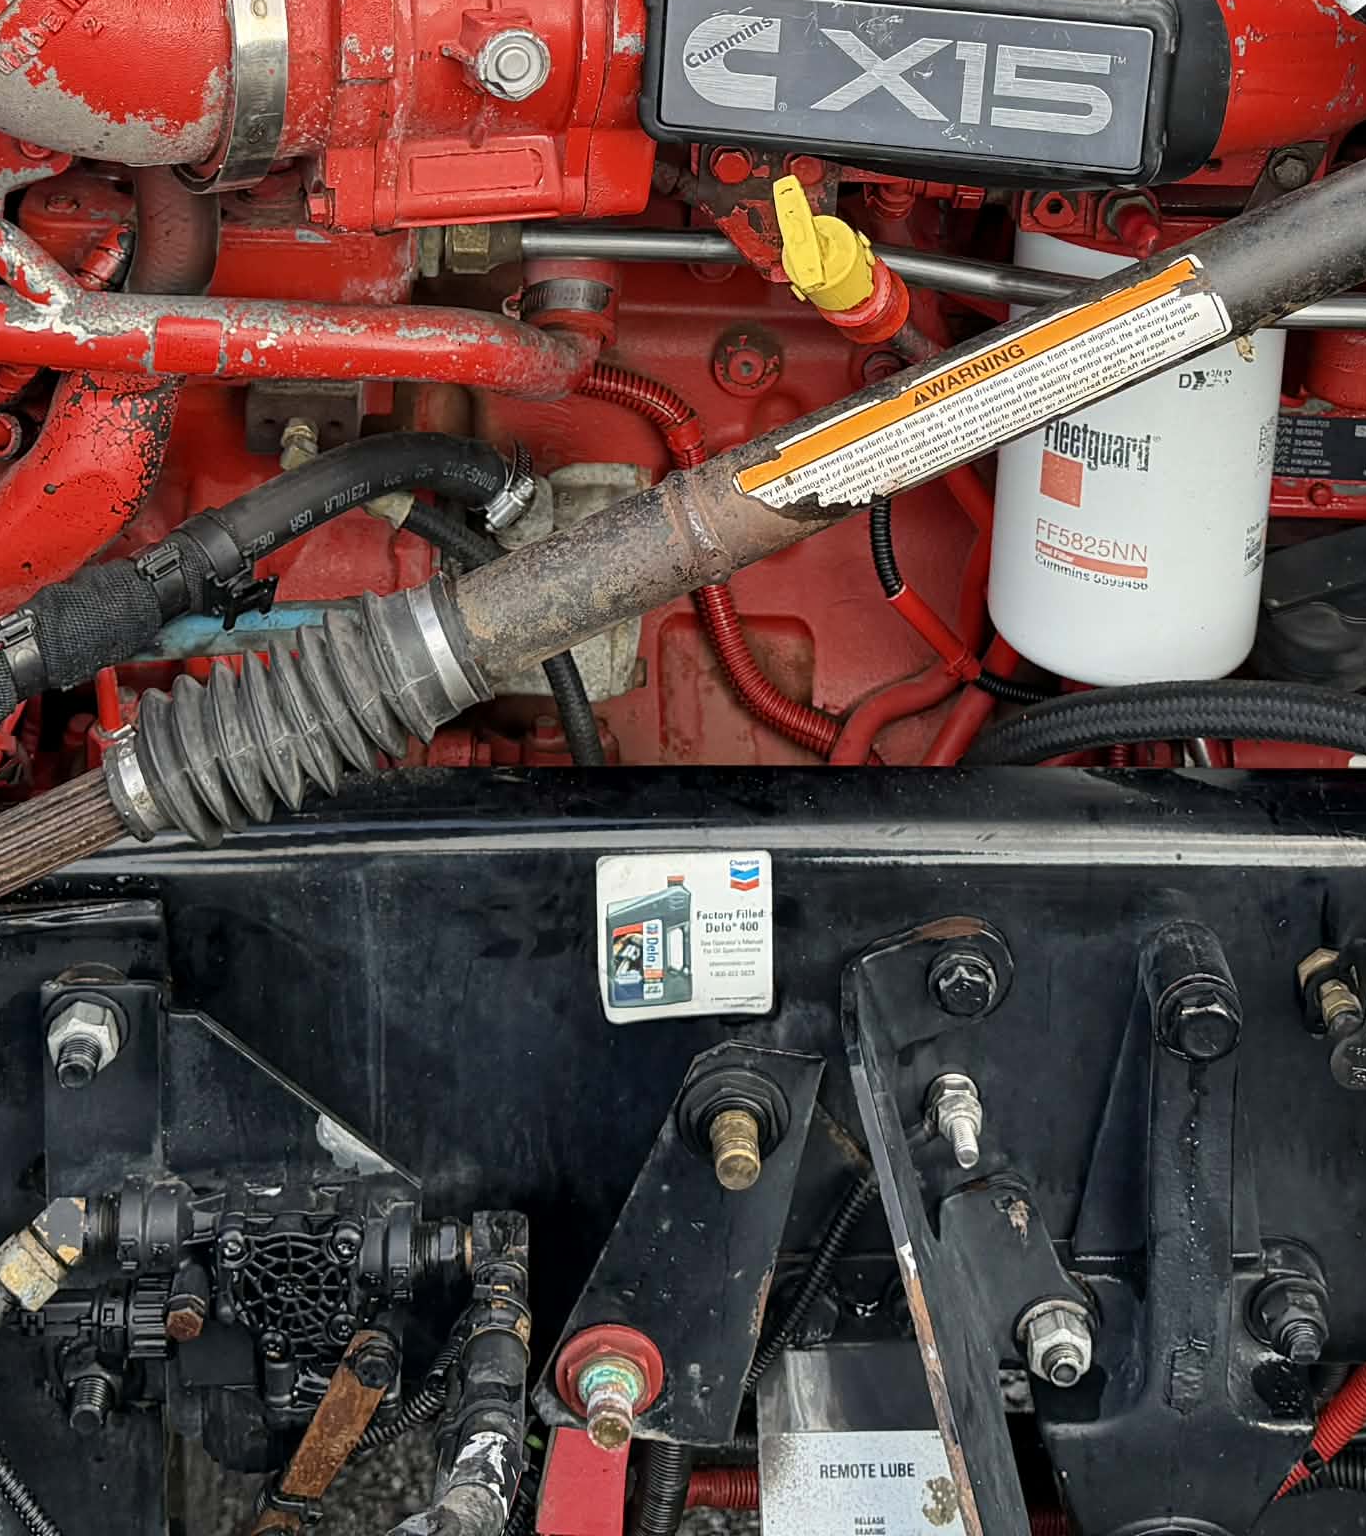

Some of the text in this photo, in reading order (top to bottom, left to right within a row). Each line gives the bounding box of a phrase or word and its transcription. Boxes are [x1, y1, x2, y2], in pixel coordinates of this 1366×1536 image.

[684, 15, 775, 71] Cummins
[809, 27, 1114, 137] X15
[791, 472, 831, 496] removed
[840, 439, 900, 473] disassembled
[909, 428, 927, 442] any
[978, 384, 1016, 409] steering
[1014, 372, 1040, 392] angle
[1039, 360, 1070, 378] sensor
[1132, 311, 1169, 335] steering
[1168, 300, 1194, 319] angle
[899, 427, 953, 458] recalibration
[977, 394, 1023, 422] performed
[1037, 370, 1073, 394] stability
[1070, 356, 1103, 376] control
[1101, 341, 1134, 362] system
[1163, 309, 1201, 332] function
[917, 440, 950, 460] control
[959, 427, 980, 442] your
[979, 411, 1011, 431] vehicle
[1009, 402, 1028, 417] and
[1027, 385, 1066, 409] personal
[1064, 373, 1090, 392] injury
[1127, 347, 1146, 362] Any
[1145, 332, 1177, 354] repairs
[924, 341, 1026, 399] WARNING
[817, 448, 854, 472] steering
[852, 433, 886, 456] system
[936, 391, 974, 416] steering
[1045, 338, 1086, 363] front-end
[1043, 419, 1152, 473] Fleetguard
[1035, 517, 1148, 563] FF5825NN
[1034, 554, 1091, 583] Cummins
[696, 910, 733, 921] Factory
[739, 921, 759, 932] 400
[819, 1462, 916, 1479] REMOTE LUBE
